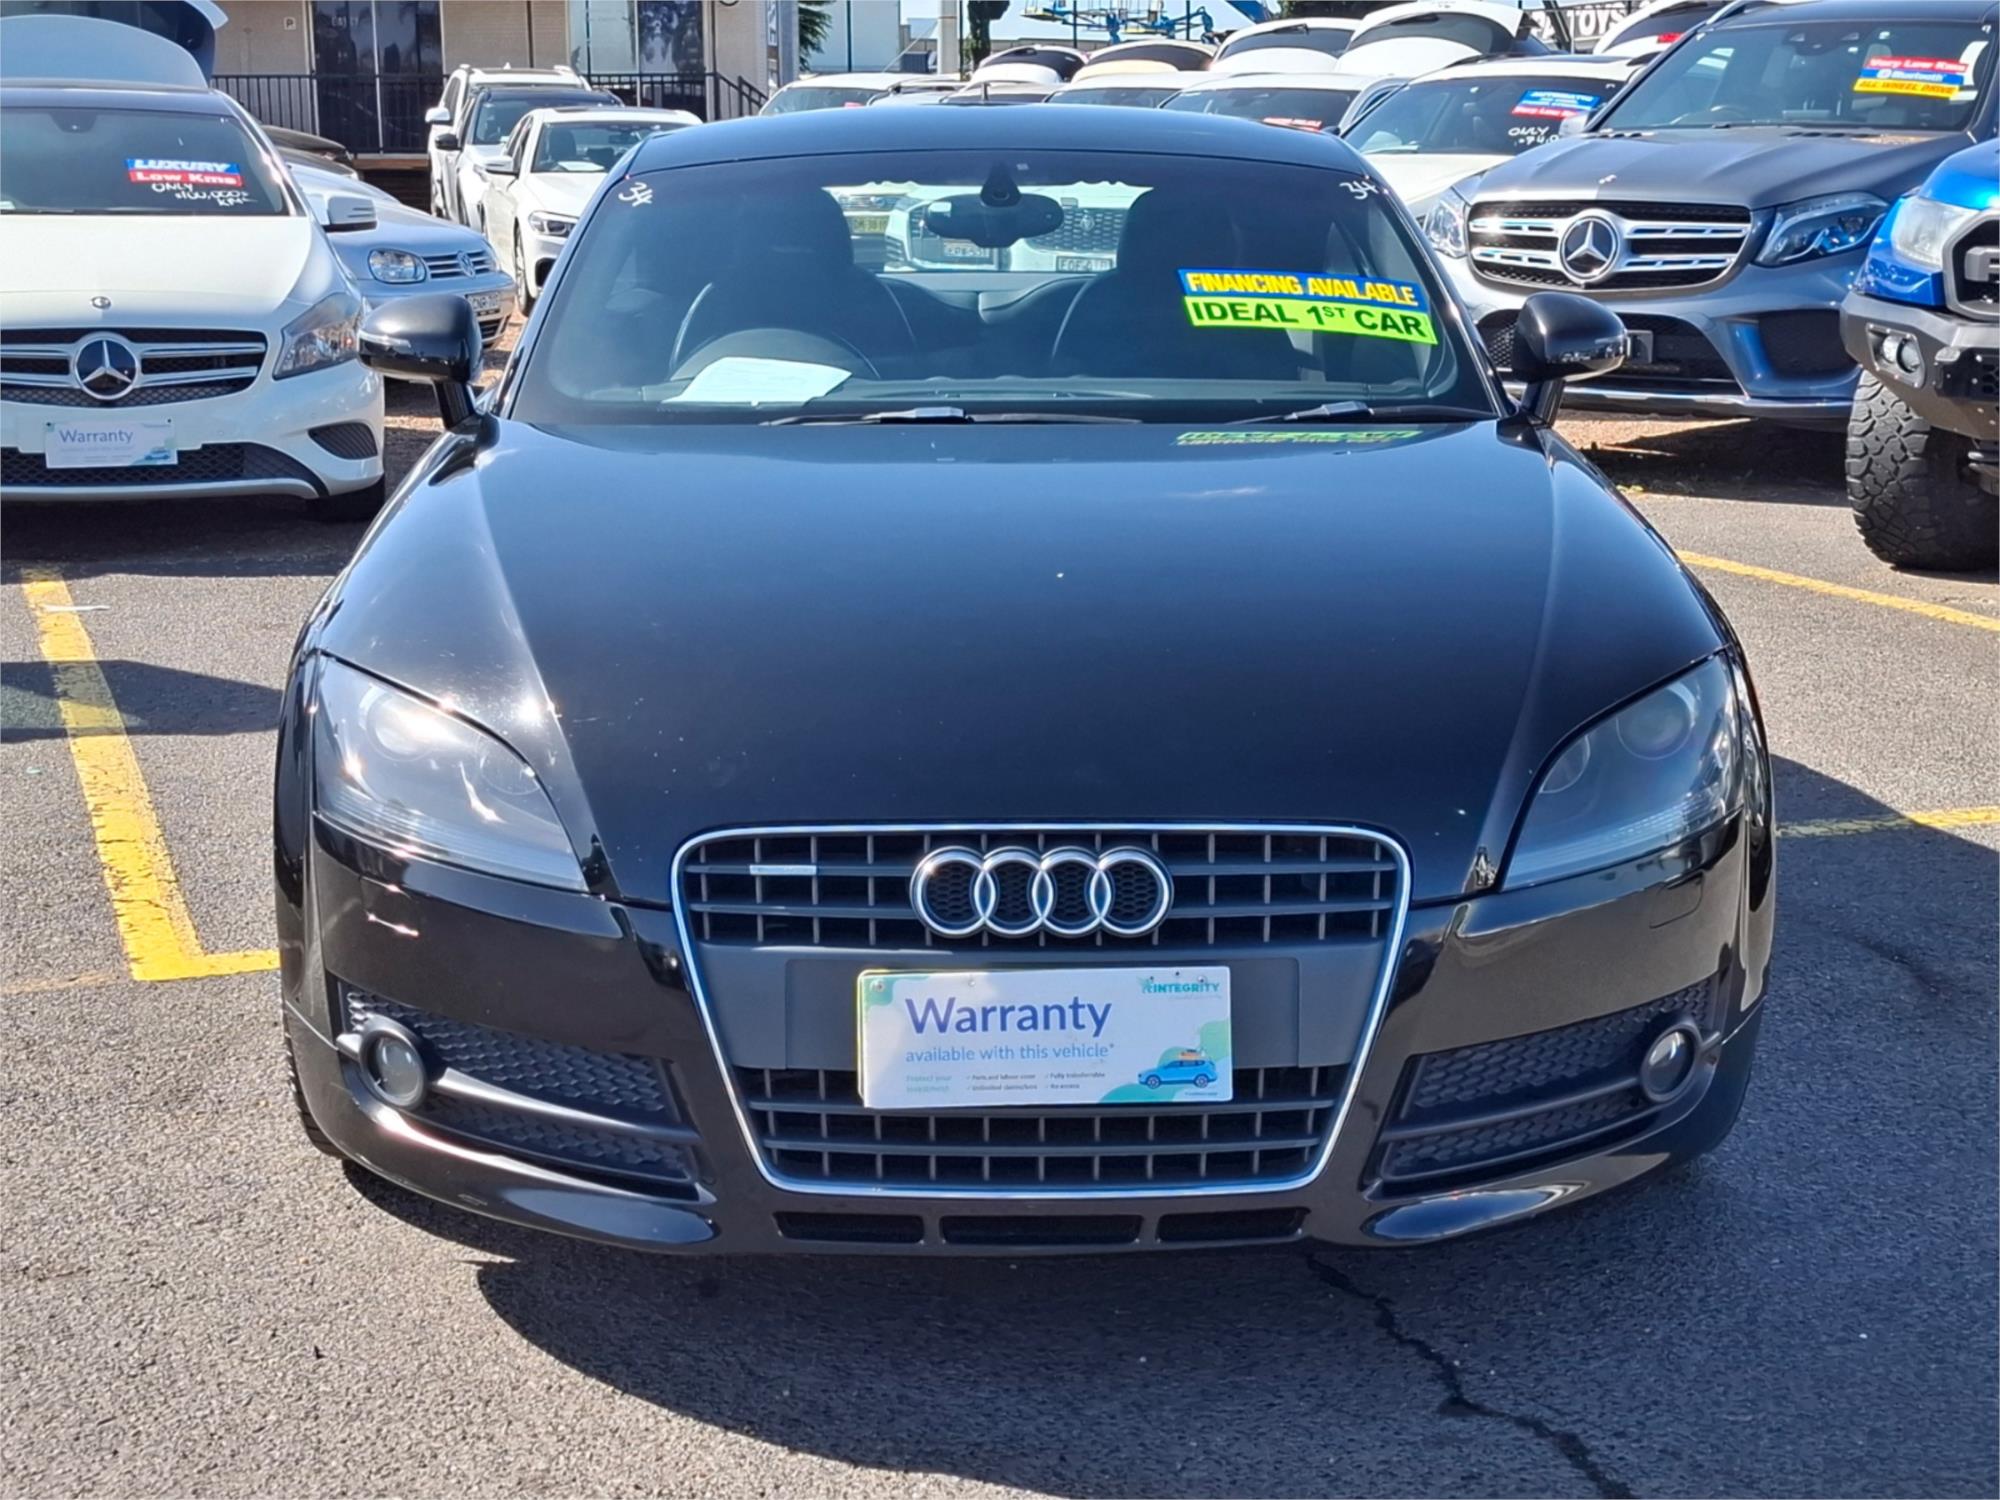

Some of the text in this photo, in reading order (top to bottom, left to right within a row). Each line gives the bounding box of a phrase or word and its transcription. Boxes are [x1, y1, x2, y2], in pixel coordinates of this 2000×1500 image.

[134, 158, 231, 173] LUXURY
[137, 170, 238, 185] Low Kms
[151, 182, 194, 193] ONLY
[1186, 271, 1419, 307] FINANCING AVAILABLE
[1192, 301, 1427, 338] IDEAL 1ST CAR
[59, 429, 134, 444] Warranty
[1153, 982, 1220, 994] INTEGRITY
[905, 996, 1113, 1037] Warranty
[905, 1045, 975, 1063] available
[979, 1045, 1015, 1061] with
[1019, 1044, 1049, 1059] this
